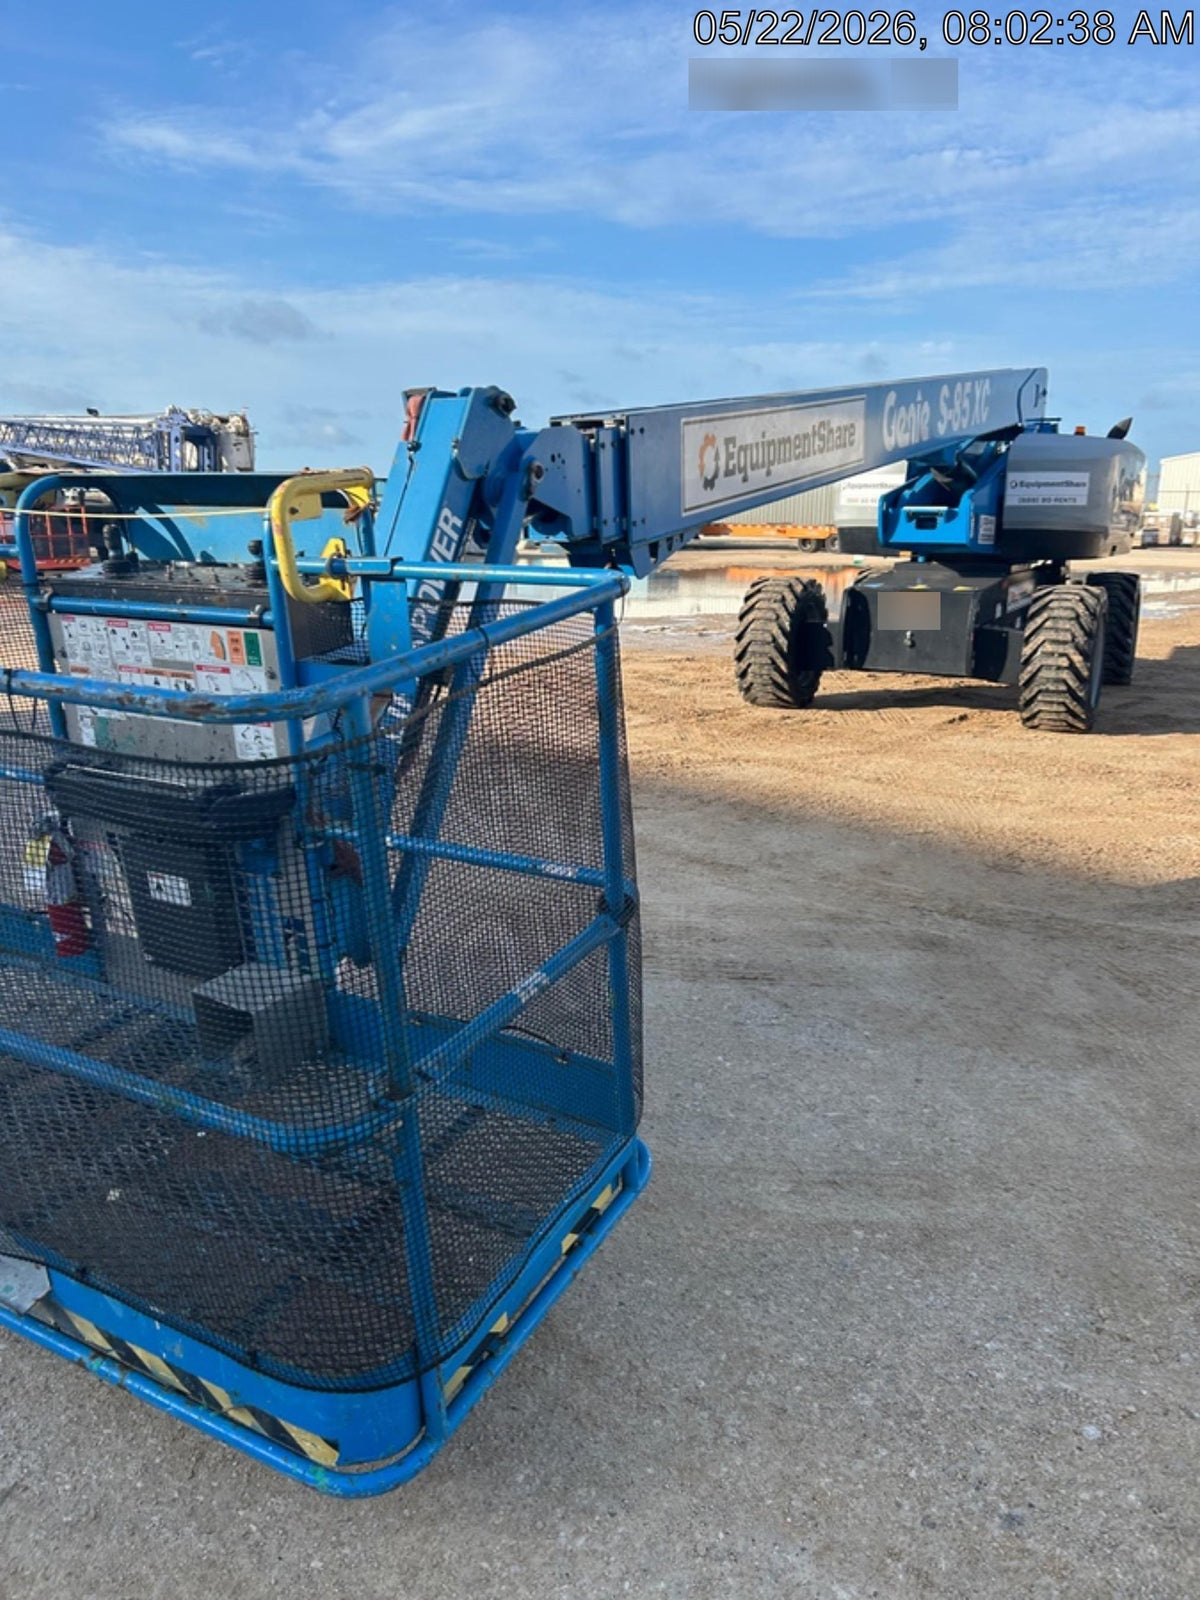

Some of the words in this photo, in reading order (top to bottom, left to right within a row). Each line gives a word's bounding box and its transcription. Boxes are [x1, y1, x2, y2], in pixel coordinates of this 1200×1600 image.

[883, 390, 930, 451] Genie
[937, 383, 973, 436] S-85
[972, 379, 991, 425] XC
[723, 419, 856, 482] EquipmentShare
[1019, 480, 1087, 489] EquipmentShare
